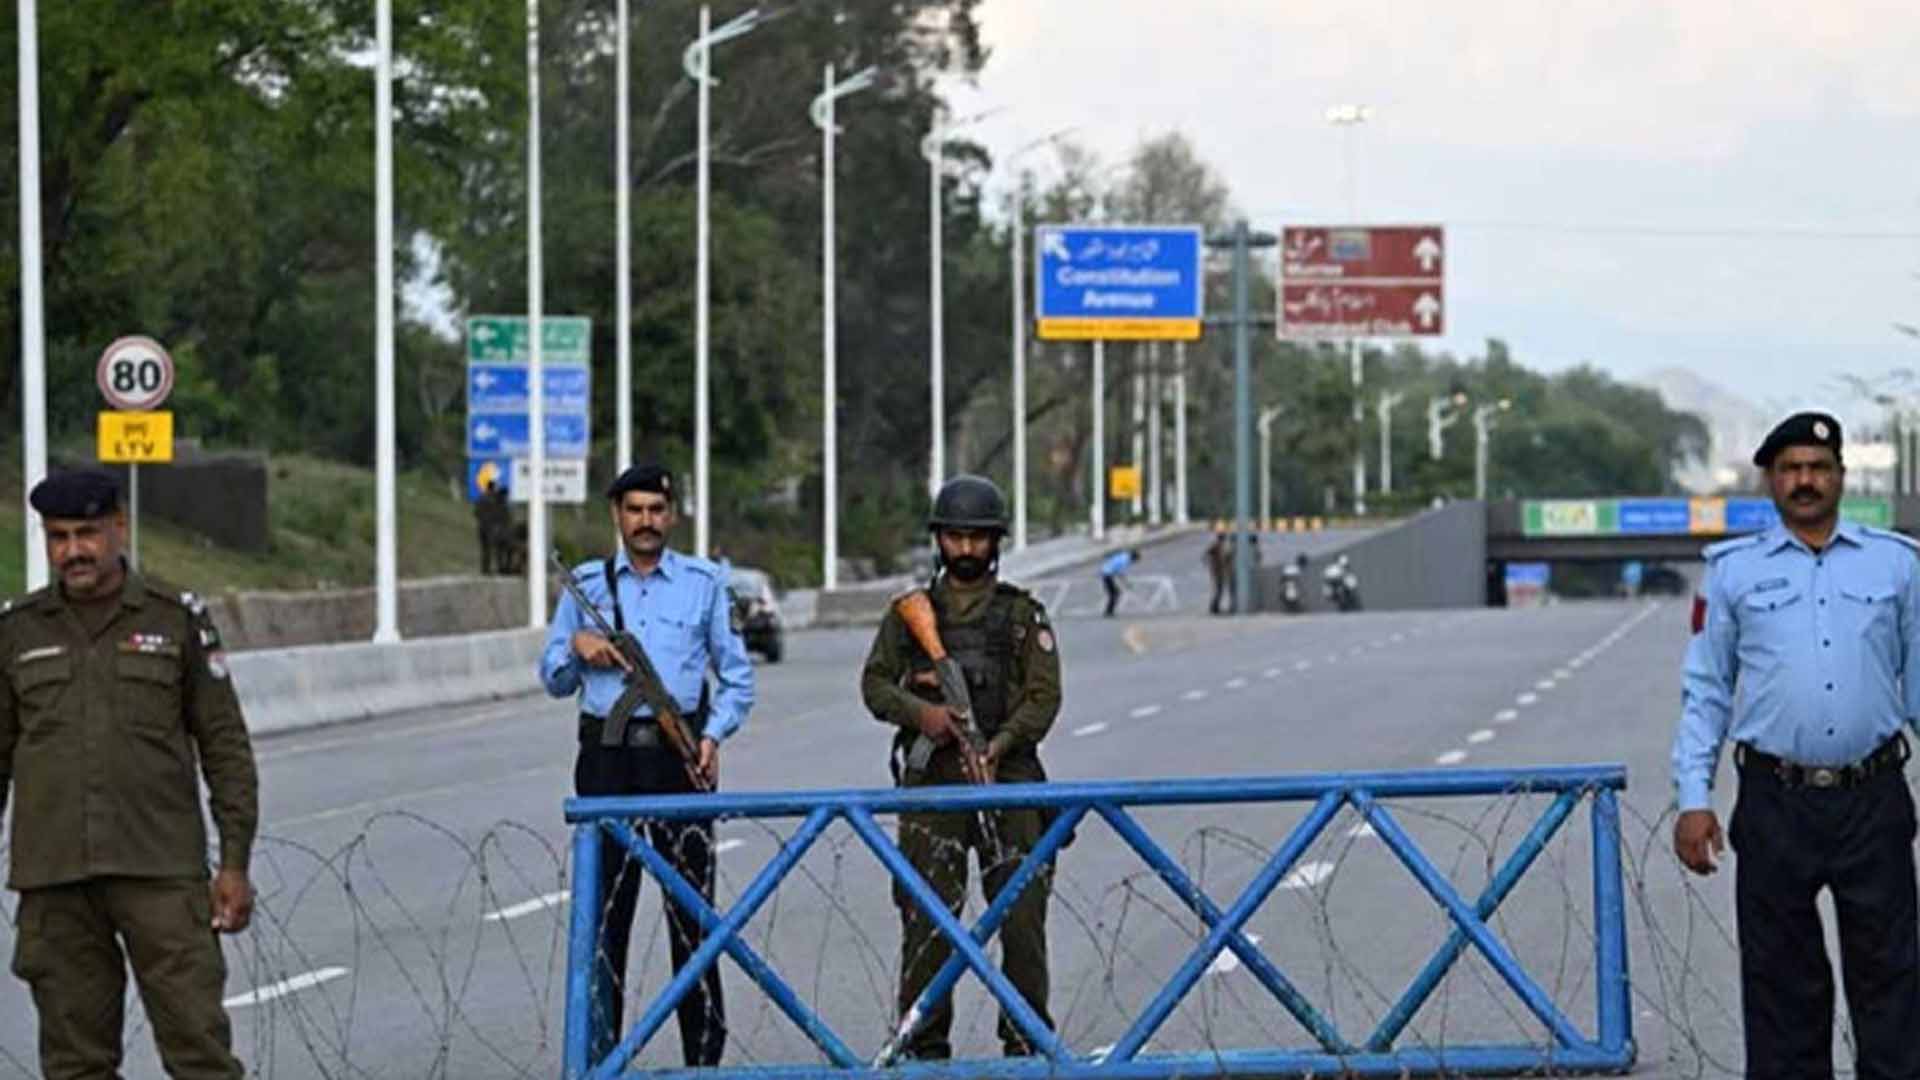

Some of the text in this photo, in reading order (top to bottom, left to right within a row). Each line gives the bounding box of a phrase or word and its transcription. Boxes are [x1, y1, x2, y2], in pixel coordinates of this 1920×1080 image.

[1057, 265, 1181, 286] Constitution
[1082, 289, 1155, 309] Avenue
[113, 359, 161, 392] 80
[113, 441, 155, 457] LTV
